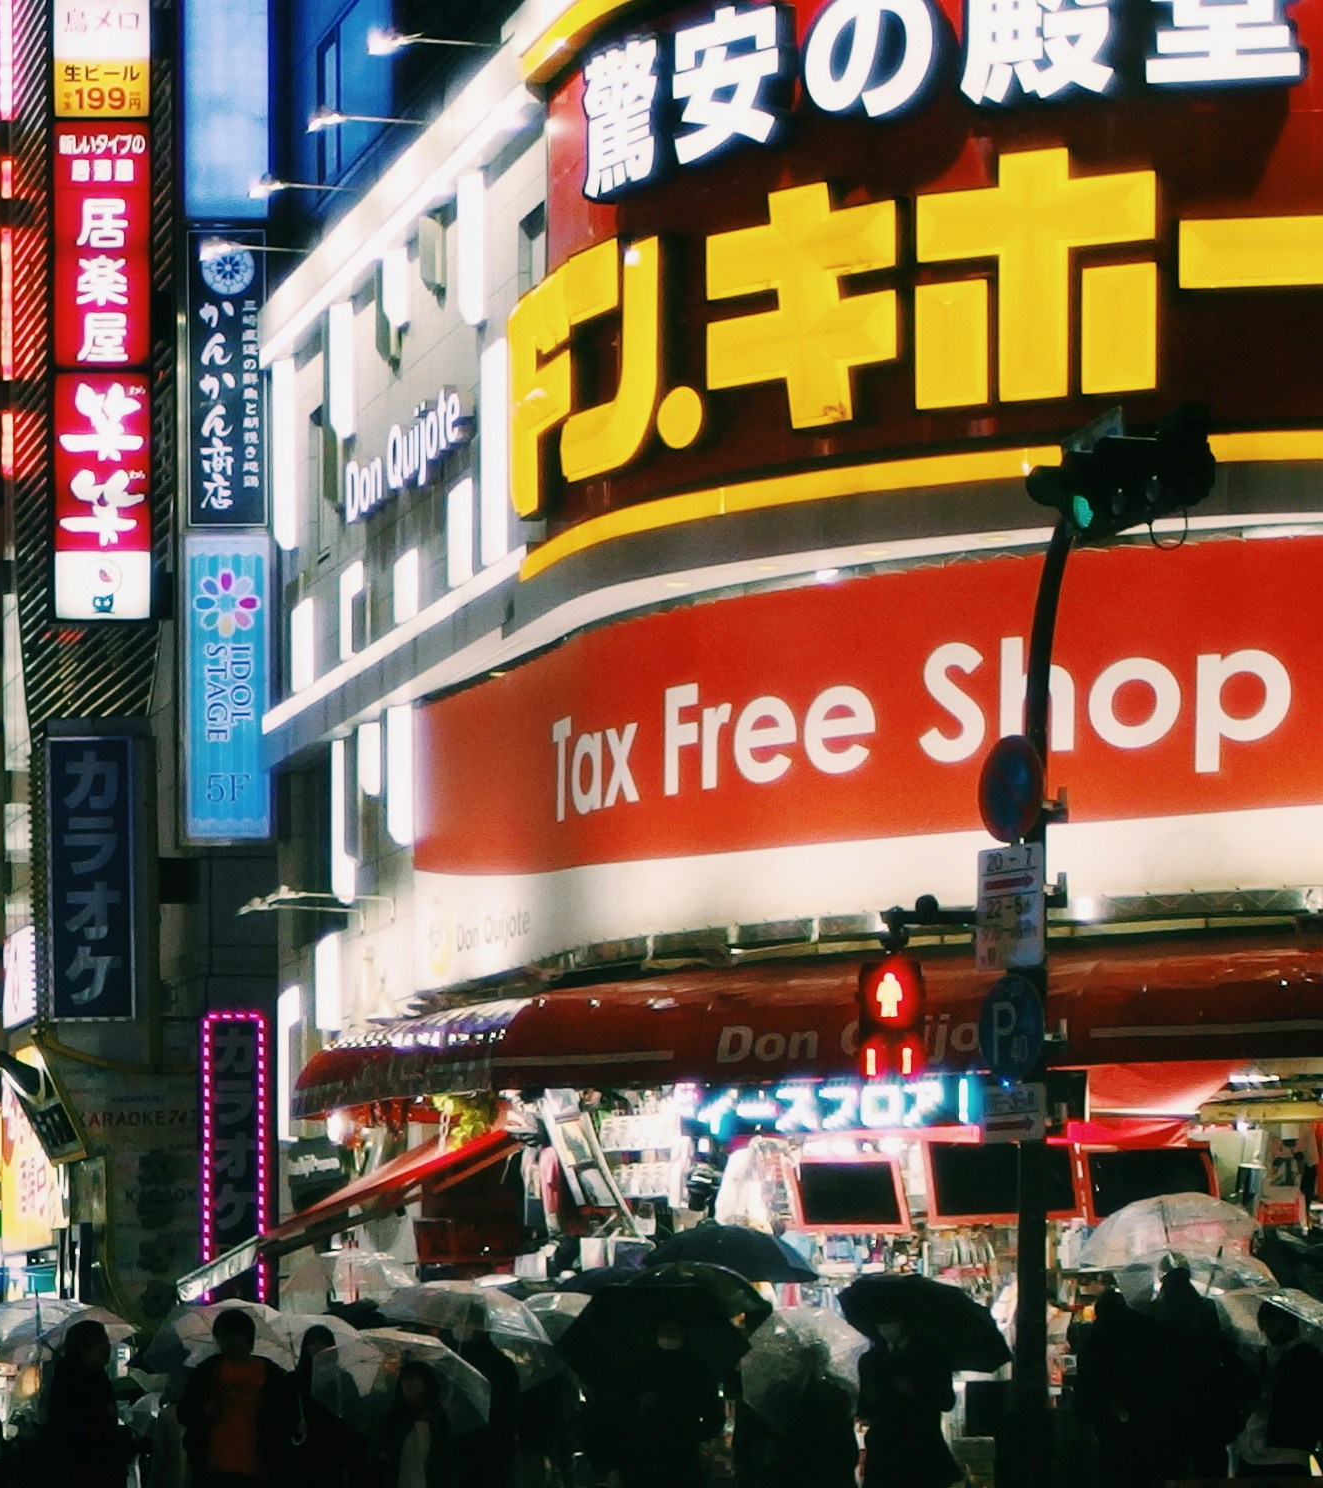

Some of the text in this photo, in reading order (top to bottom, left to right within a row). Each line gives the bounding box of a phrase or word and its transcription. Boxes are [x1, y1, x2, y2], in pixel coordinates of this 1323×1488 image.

[64, 9, 140, 33] 鳥メロ
[64, 65, 140, 83] 生ビール
[59, 134, 145, 155] 新しいタイプの
[71, 159, 134, 182] 居酒屋
[76, 197, 129, 364] 居楽屋
[199, 300, 236, 510] かんかん商店
[346, 390, 462, 523] Don Quijote
[204, 643, 230, 744] STAGE
[228, 644, 253, 725] IDOL
[552, 635, 1293, 823] Tax Free Shop
[207, 774, 250, 802] 5F
[64, 749, 123, 1006] カラオケ
[457, 923, 480, 953] Don
[716, 1025, 819, 1064] Don
[993, 1001, 1016, 1067] P
[214, 1025, 251, 1228] カラオケ
